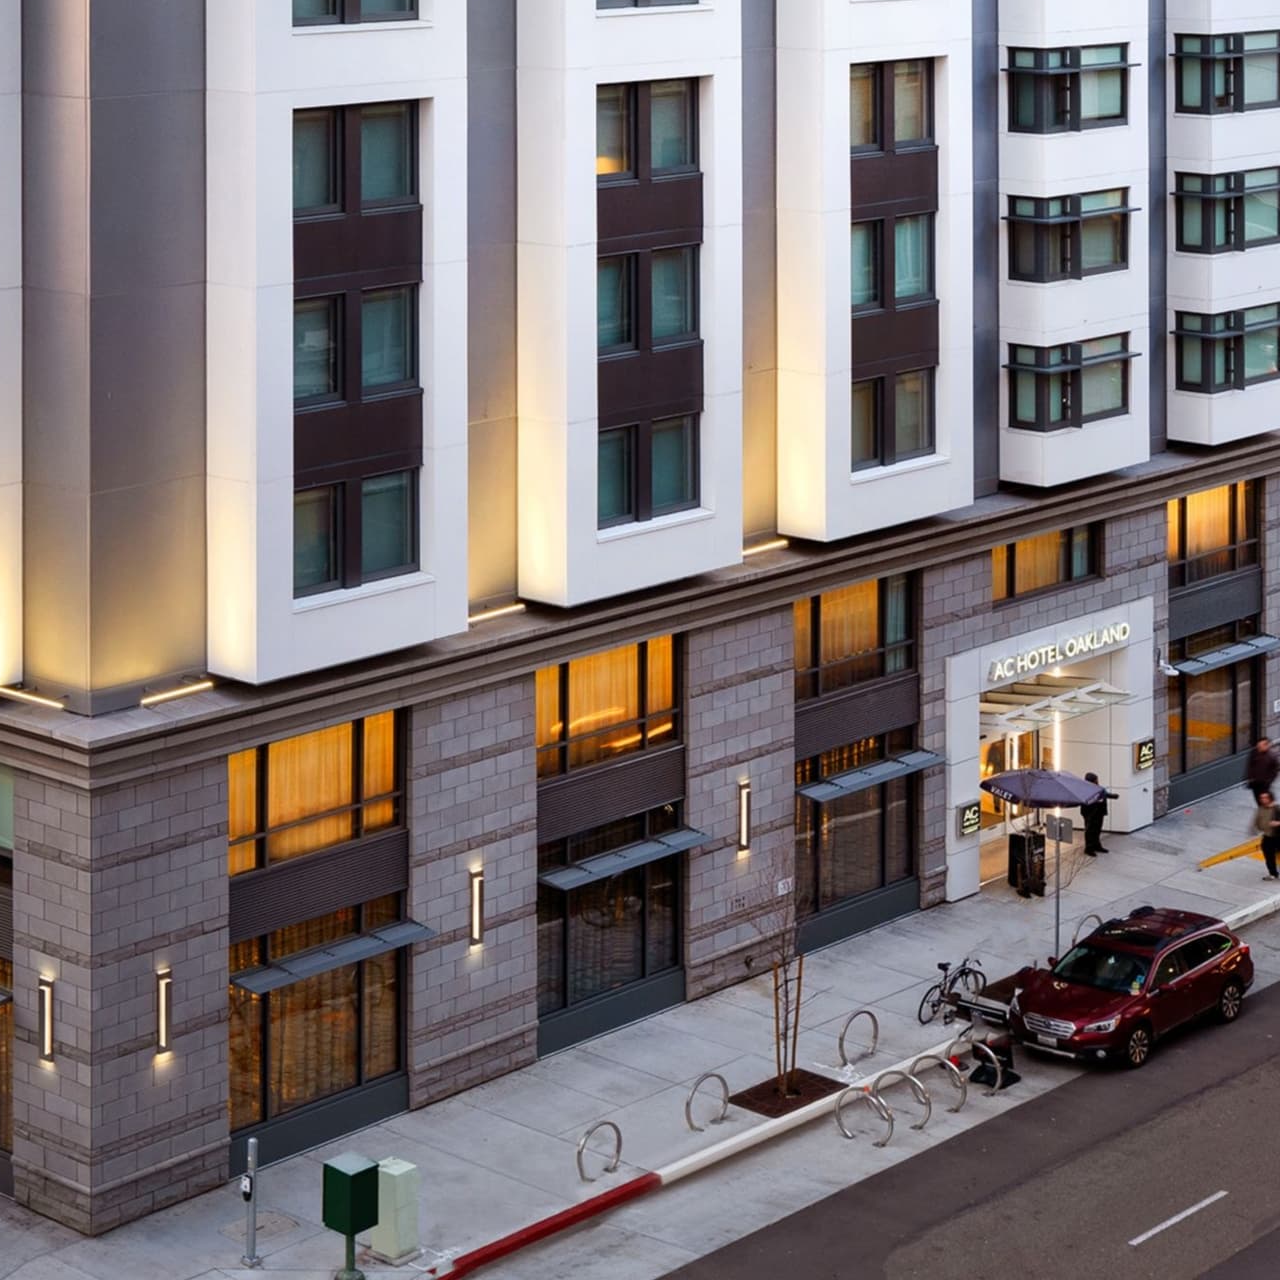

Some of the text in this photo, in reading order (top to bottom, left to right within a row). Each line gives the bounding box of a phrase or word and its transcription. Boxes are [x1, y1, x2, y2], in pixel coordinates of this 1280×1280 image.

[993, 623, 1131, 681] AC HOTEL OAKLAND
[1140, 743, 1154, 757] AC
[990, 786, 1013, 801] VALET
[963, 806, 979, 822] AC
